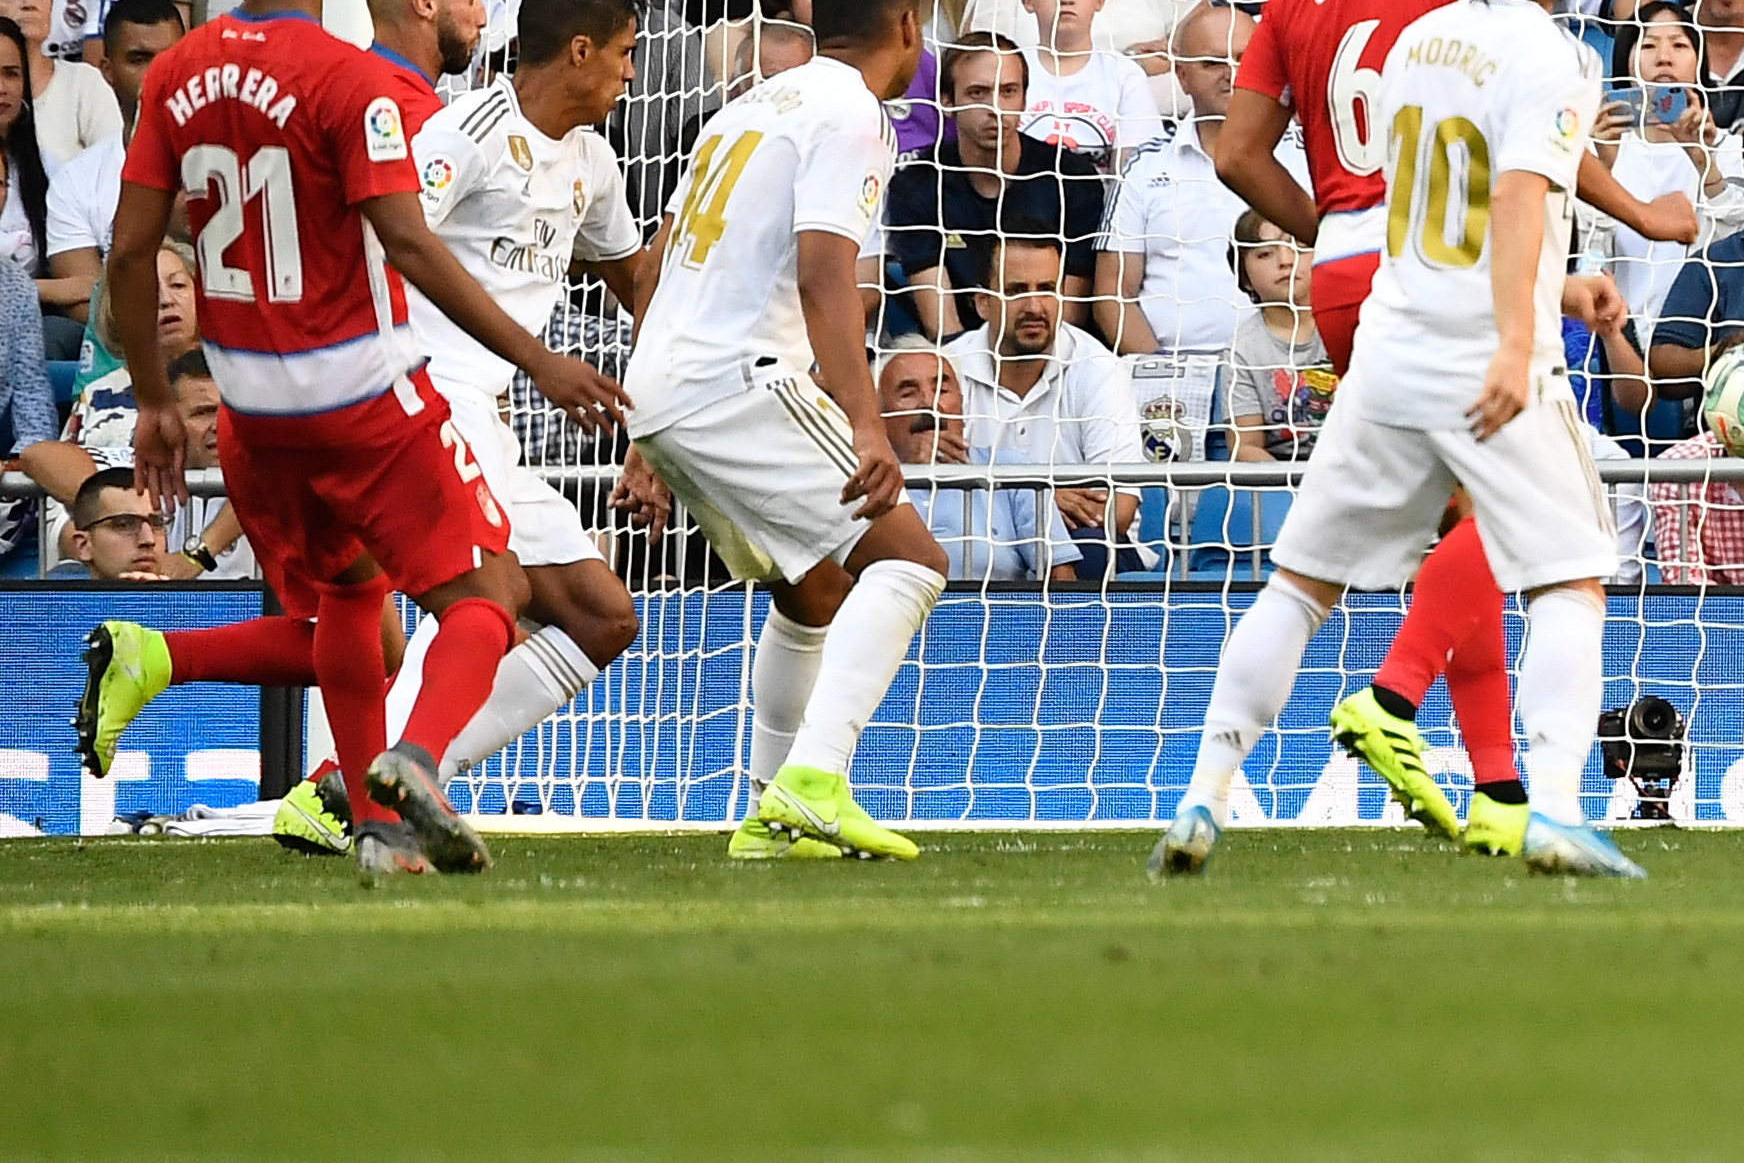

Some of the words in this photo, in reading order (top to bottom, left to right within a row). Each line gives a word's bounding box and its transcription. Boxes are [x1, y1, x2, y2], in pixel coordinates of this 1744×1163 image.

[165, 63, 298, 129] HERRERA
[1327, 18, 1384, 177] 6
[181, 142, 304, 304] 21
[533, 217, 557, 249] Fly
[672, 130, 765, 271] 14
[1386, 103, 1493, 270] 10
